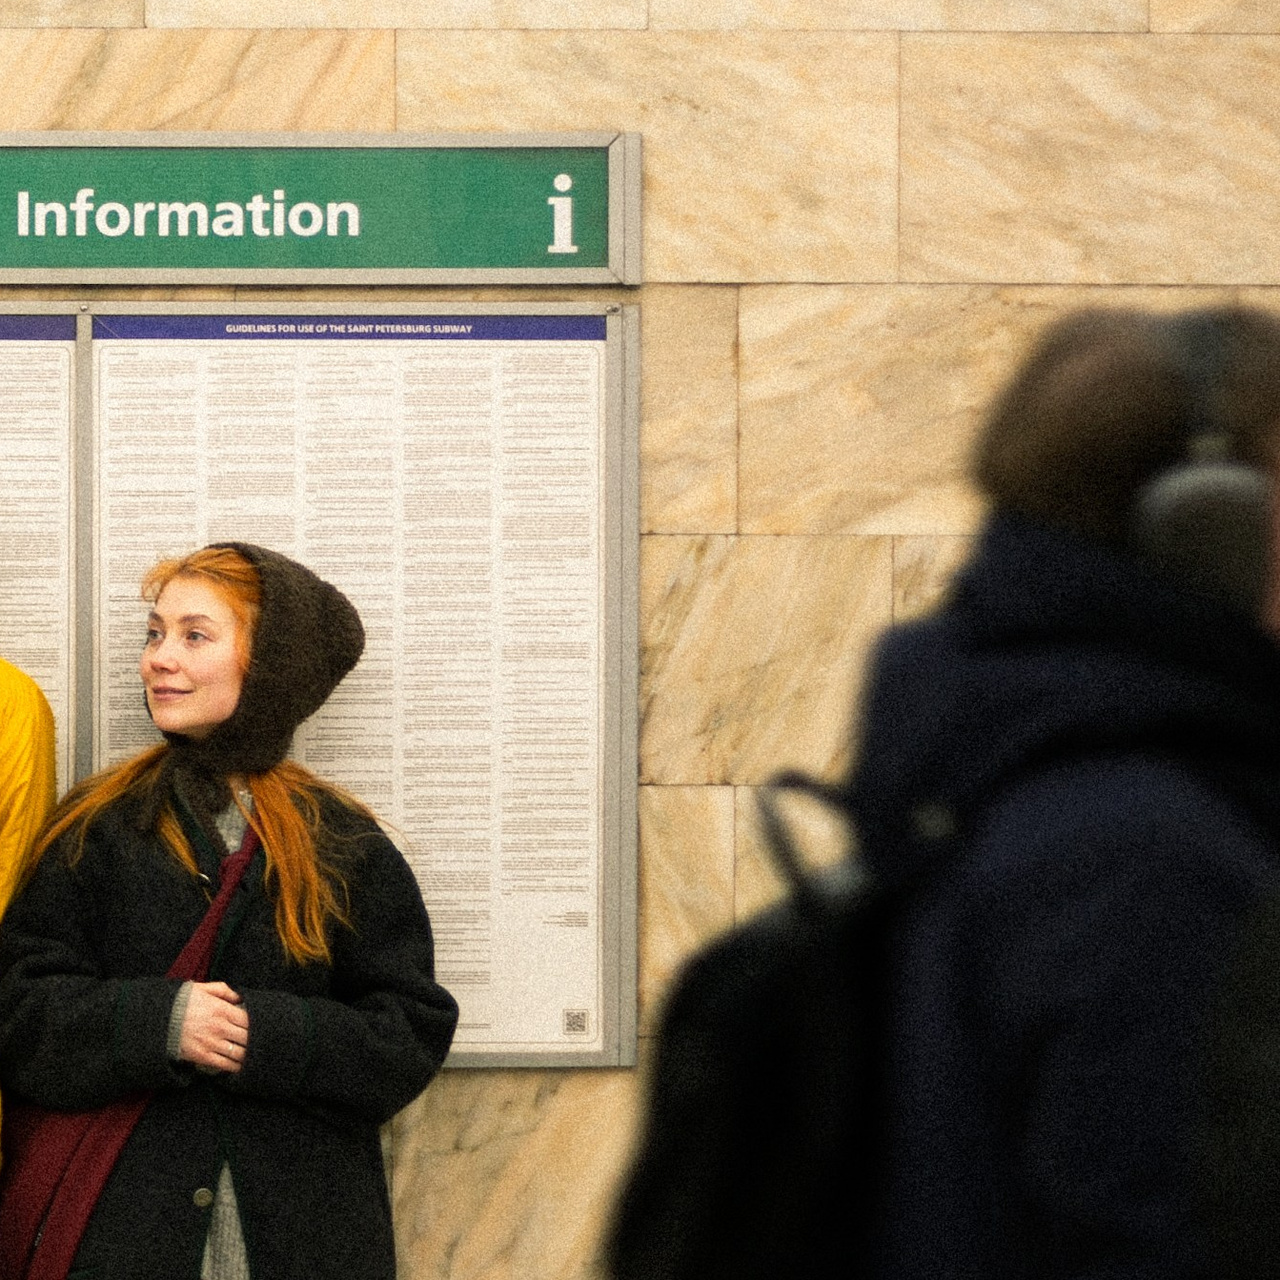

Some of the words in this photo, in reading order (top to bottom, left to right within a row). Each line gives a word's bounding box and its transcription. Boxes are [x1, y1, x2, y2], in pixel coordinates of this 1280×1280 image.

[16, 187, 361, 238] Information
[225, 324, 277, 334] GUIDELINES
[278, 324, 297, 334] FOR
[297, 324, 315, 334] USE
[316, 324, 329, 334] OF
[329, 324, 347, 334] THE
[347, 324, 375, 334] SAINT
[375, 324, 433, 334] PETERSBURG
[433, 324, 473, 334] SUBWAY
